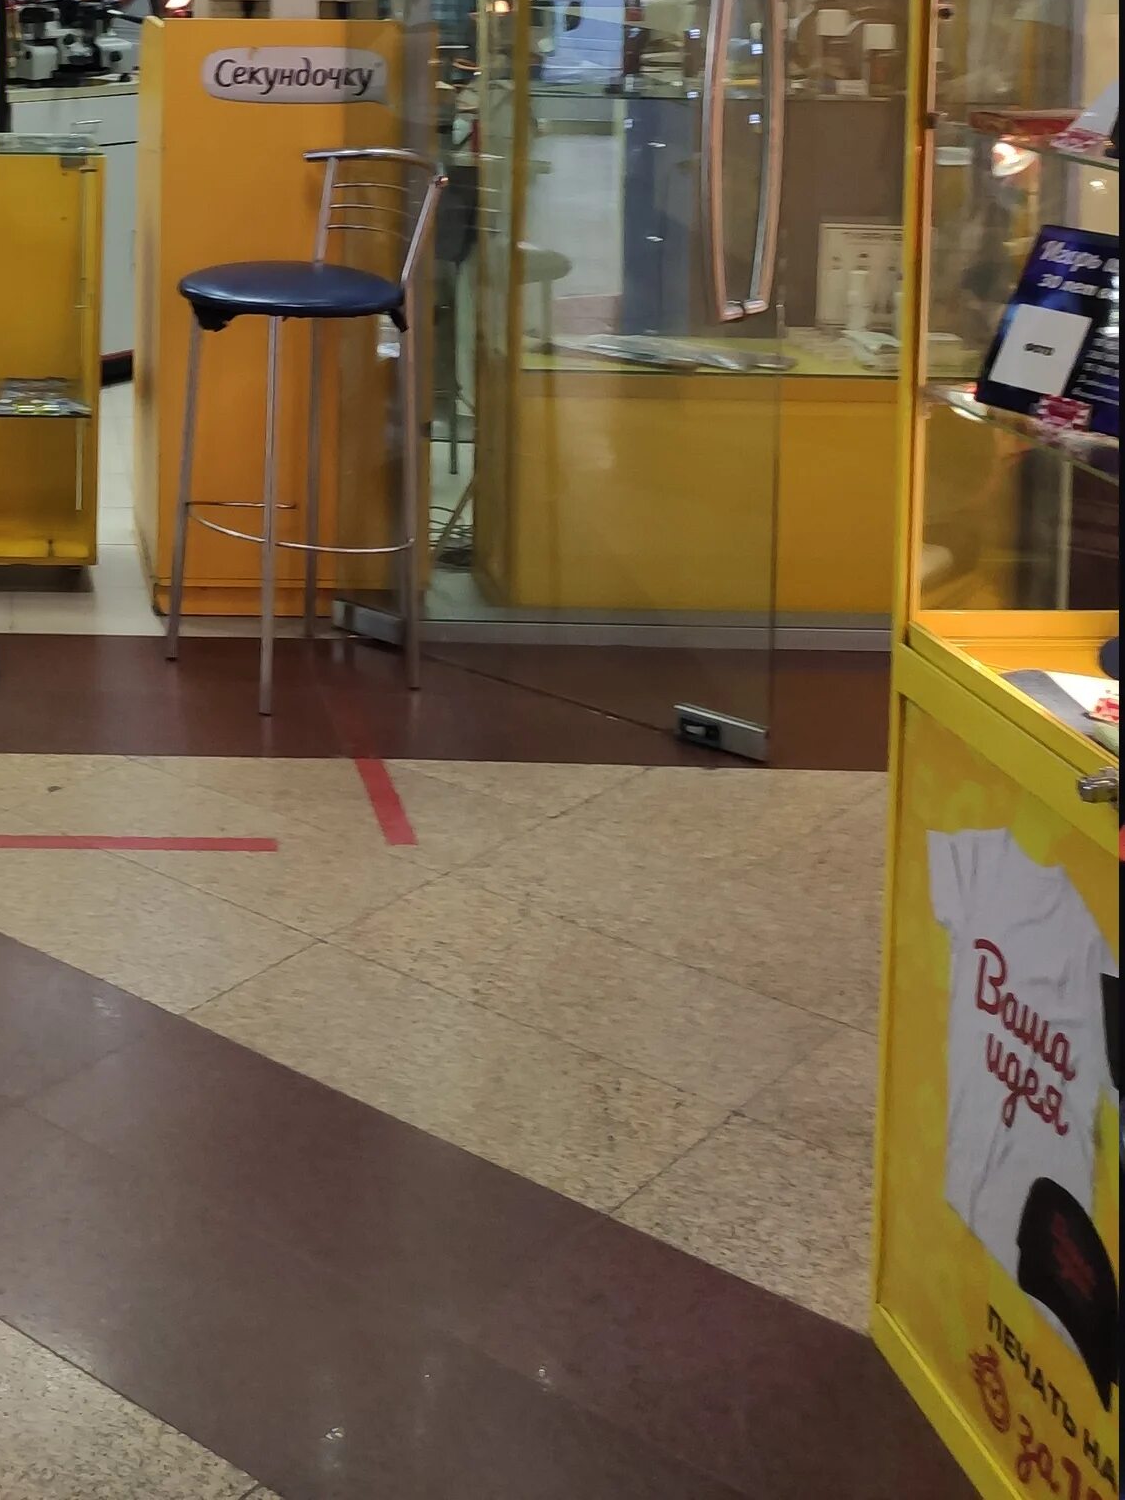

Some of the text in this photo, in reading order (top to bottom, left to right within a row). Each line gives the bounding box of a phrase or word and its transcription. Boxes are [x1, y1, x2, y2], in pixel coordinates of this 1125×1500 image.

[214, 57, 374, 96] Секундочку
[974, 938, 1075, 1081] Ваша
[986, 1033, 1070, 1136] идея
[987, 1303, 1078, 1439] ПЕЧАТЬ
[1082, 1428, 1118, 1494] НА
